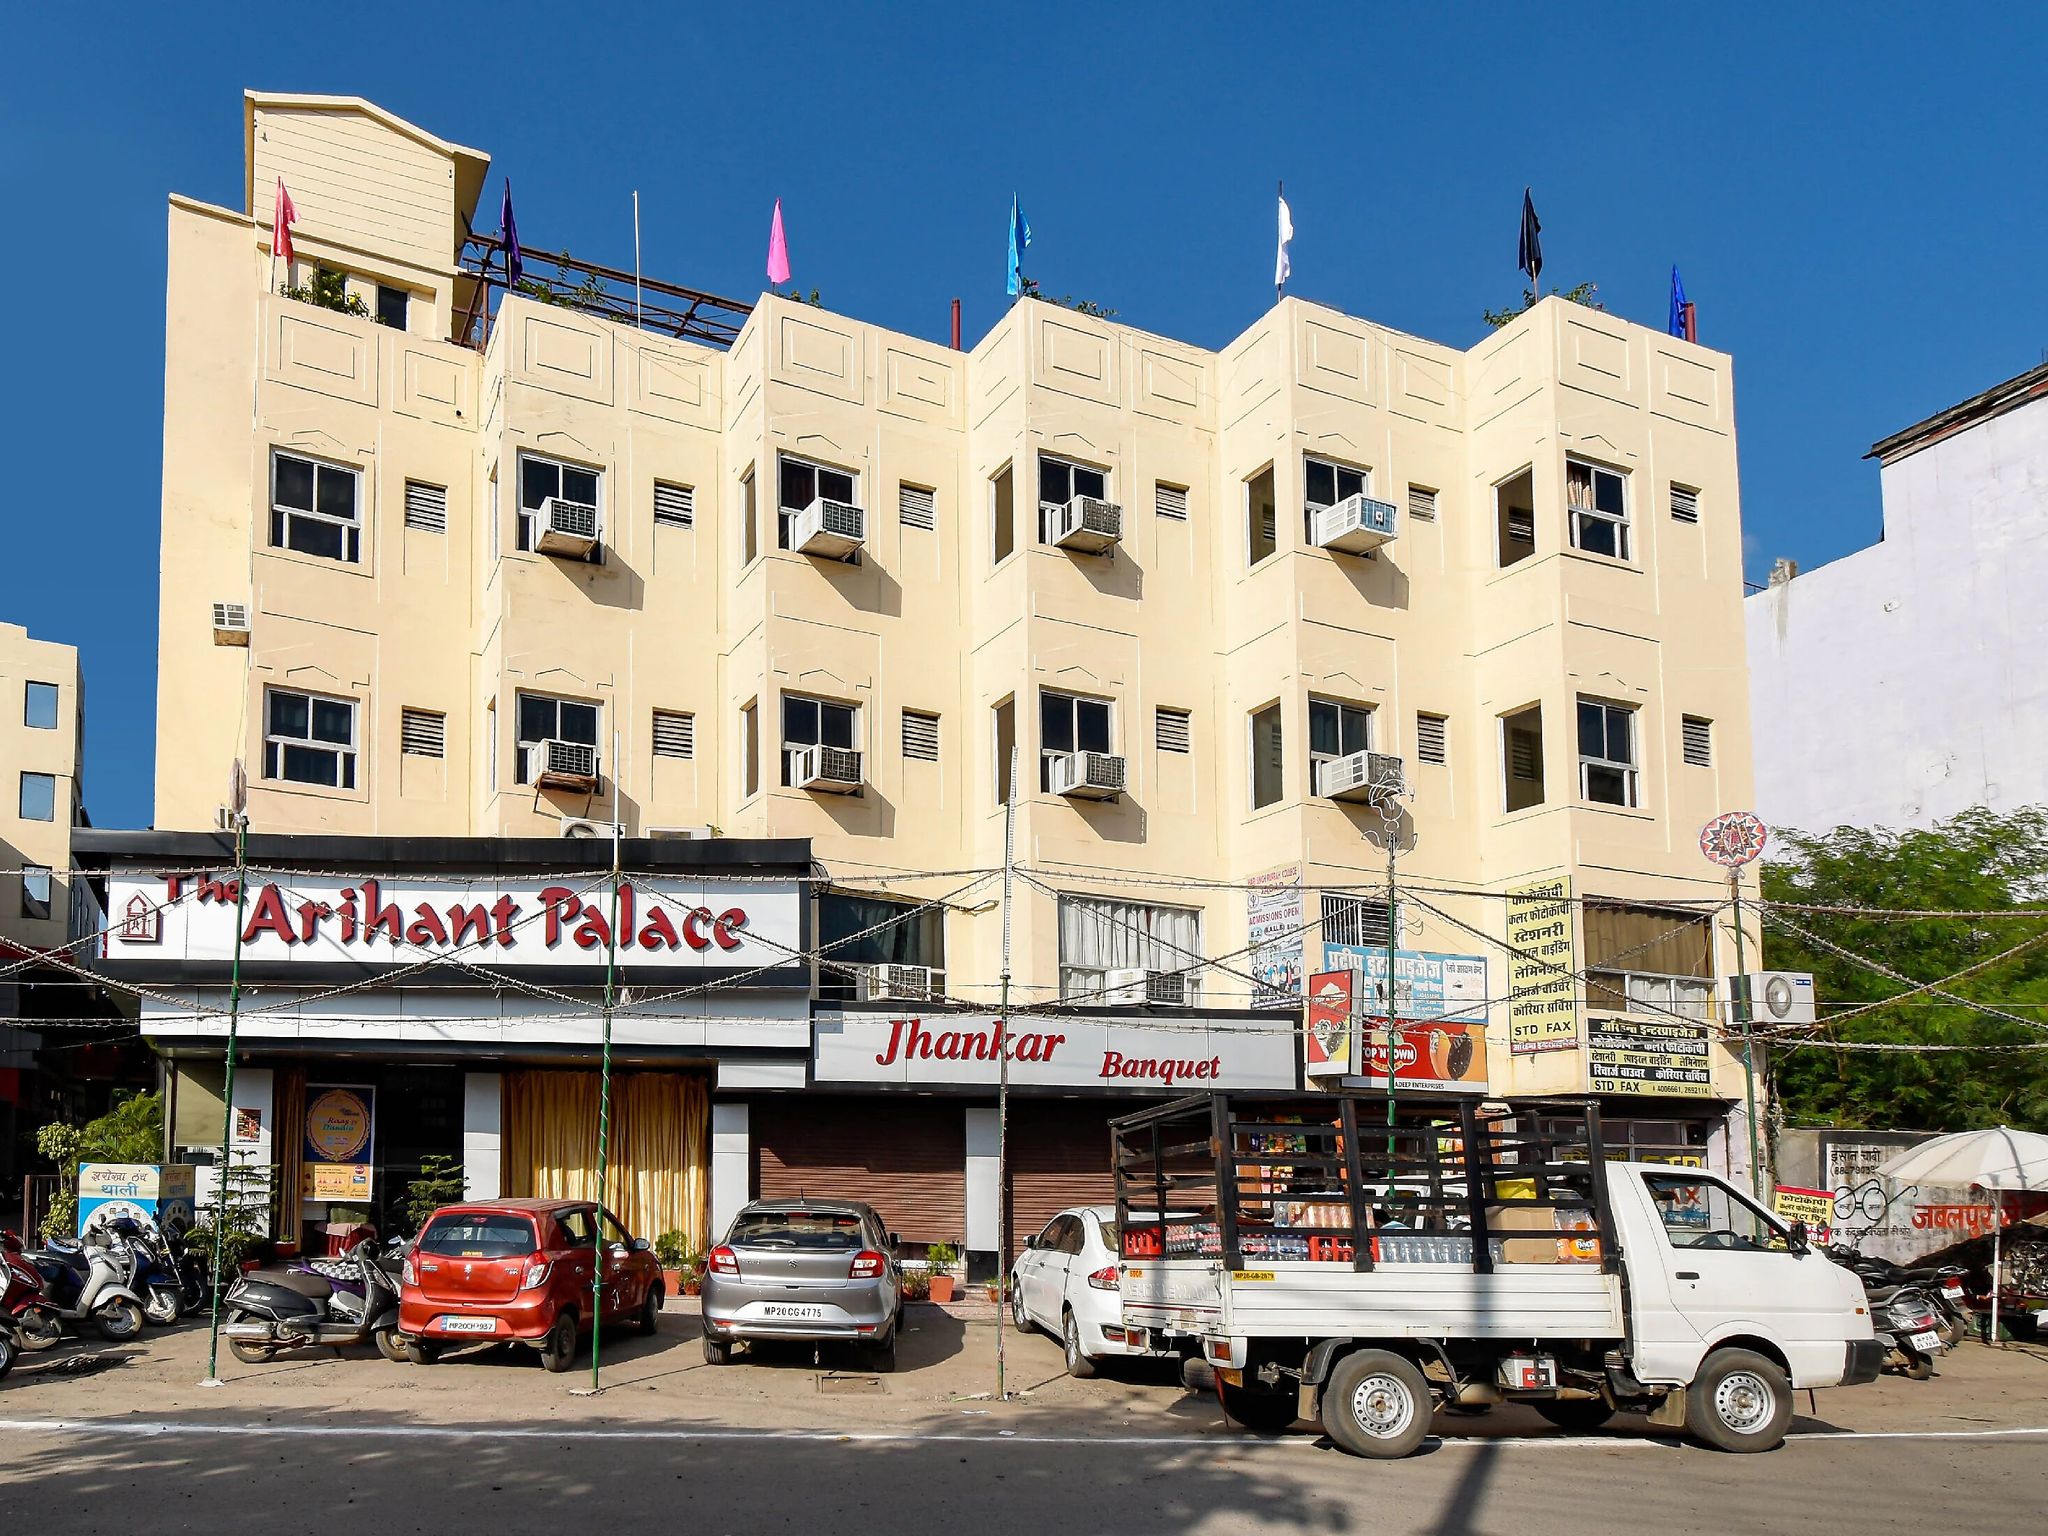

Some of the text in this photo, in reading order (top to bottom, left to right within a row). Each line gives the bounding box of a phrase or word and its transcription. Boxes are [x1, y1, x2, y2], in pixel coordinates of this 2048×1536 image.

[156, 873, 247, 903] The
[241, 879, 748, 950] Arihant Palace
[1514, 921, 1564, 943] स्टेशनरी
[1515, 1021, 1571, 1036] STD FAX
[876, 1018, 1221, 1086] Jhankar Banquet
[1620, 1081, 1640, 1092] FAX
[101, 1182, 139, 1196] थाली
